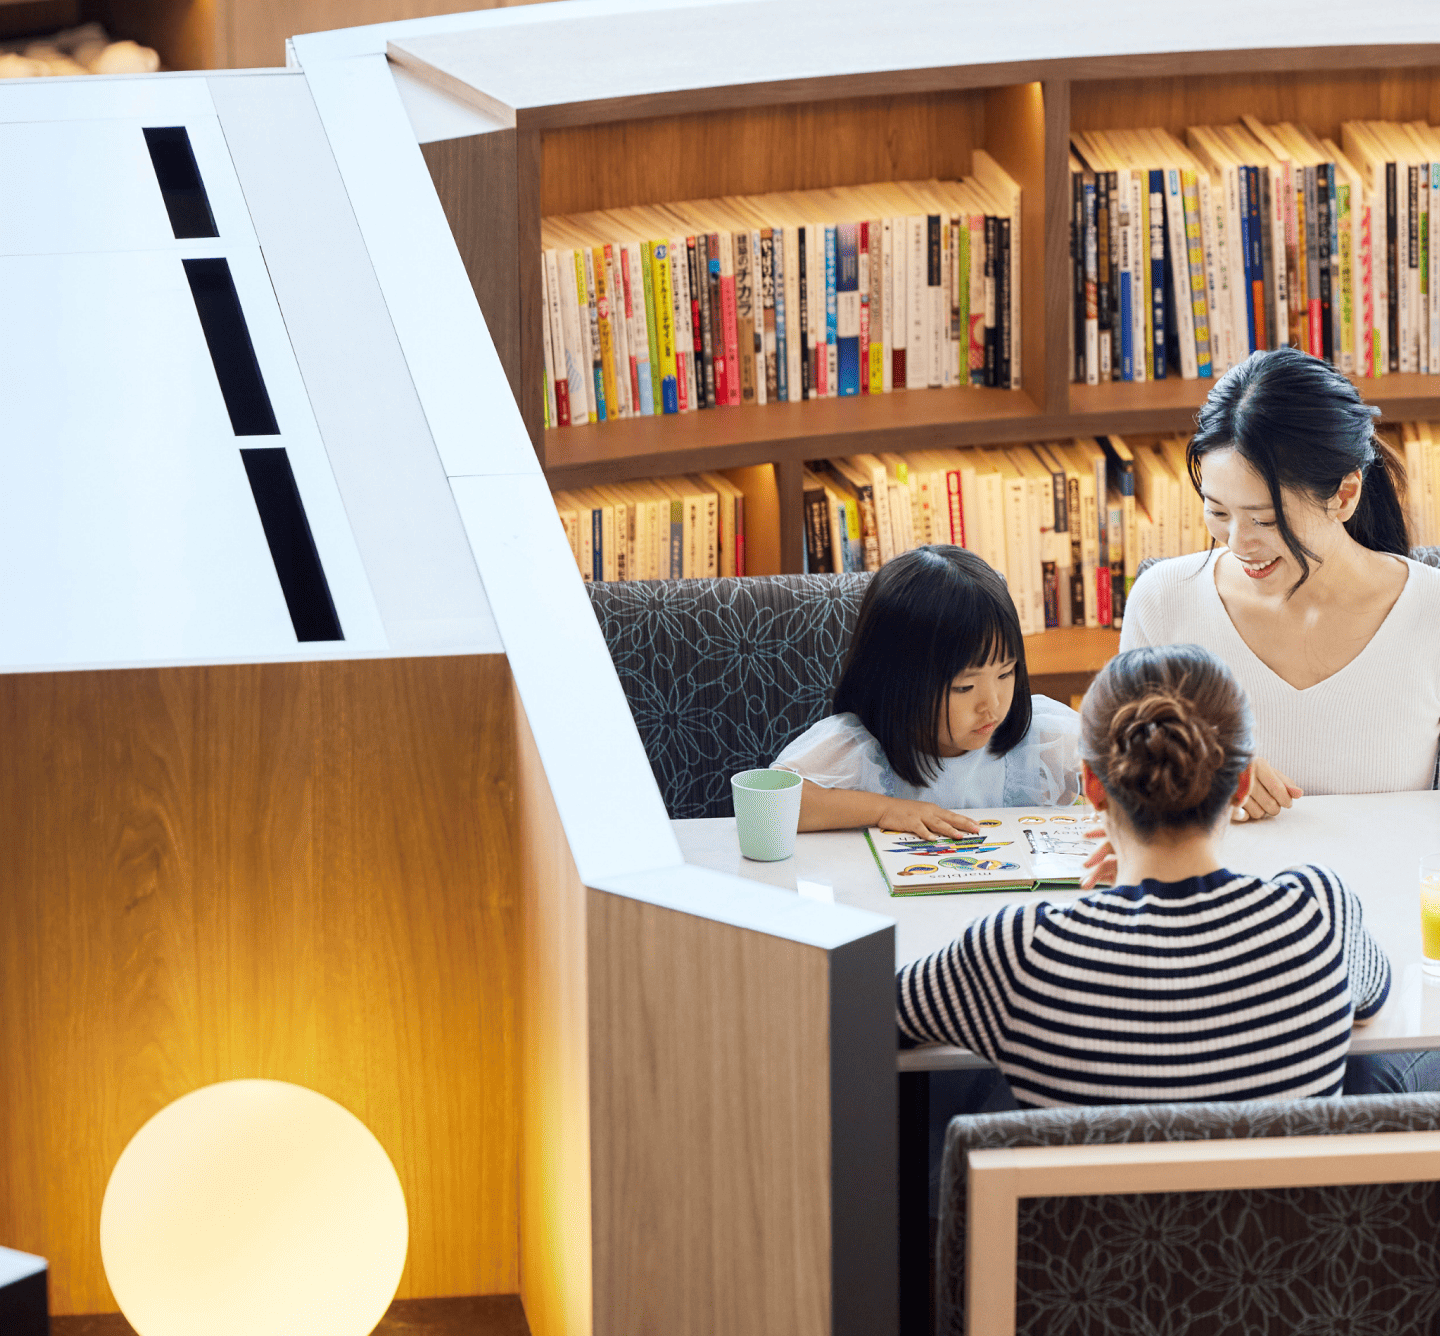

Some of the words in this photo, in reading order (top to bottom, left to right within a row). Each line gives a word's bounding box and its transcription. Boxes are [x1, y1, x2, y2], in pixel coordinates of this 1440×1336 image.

[736, 233, 752, 317] 建築のチカラ
